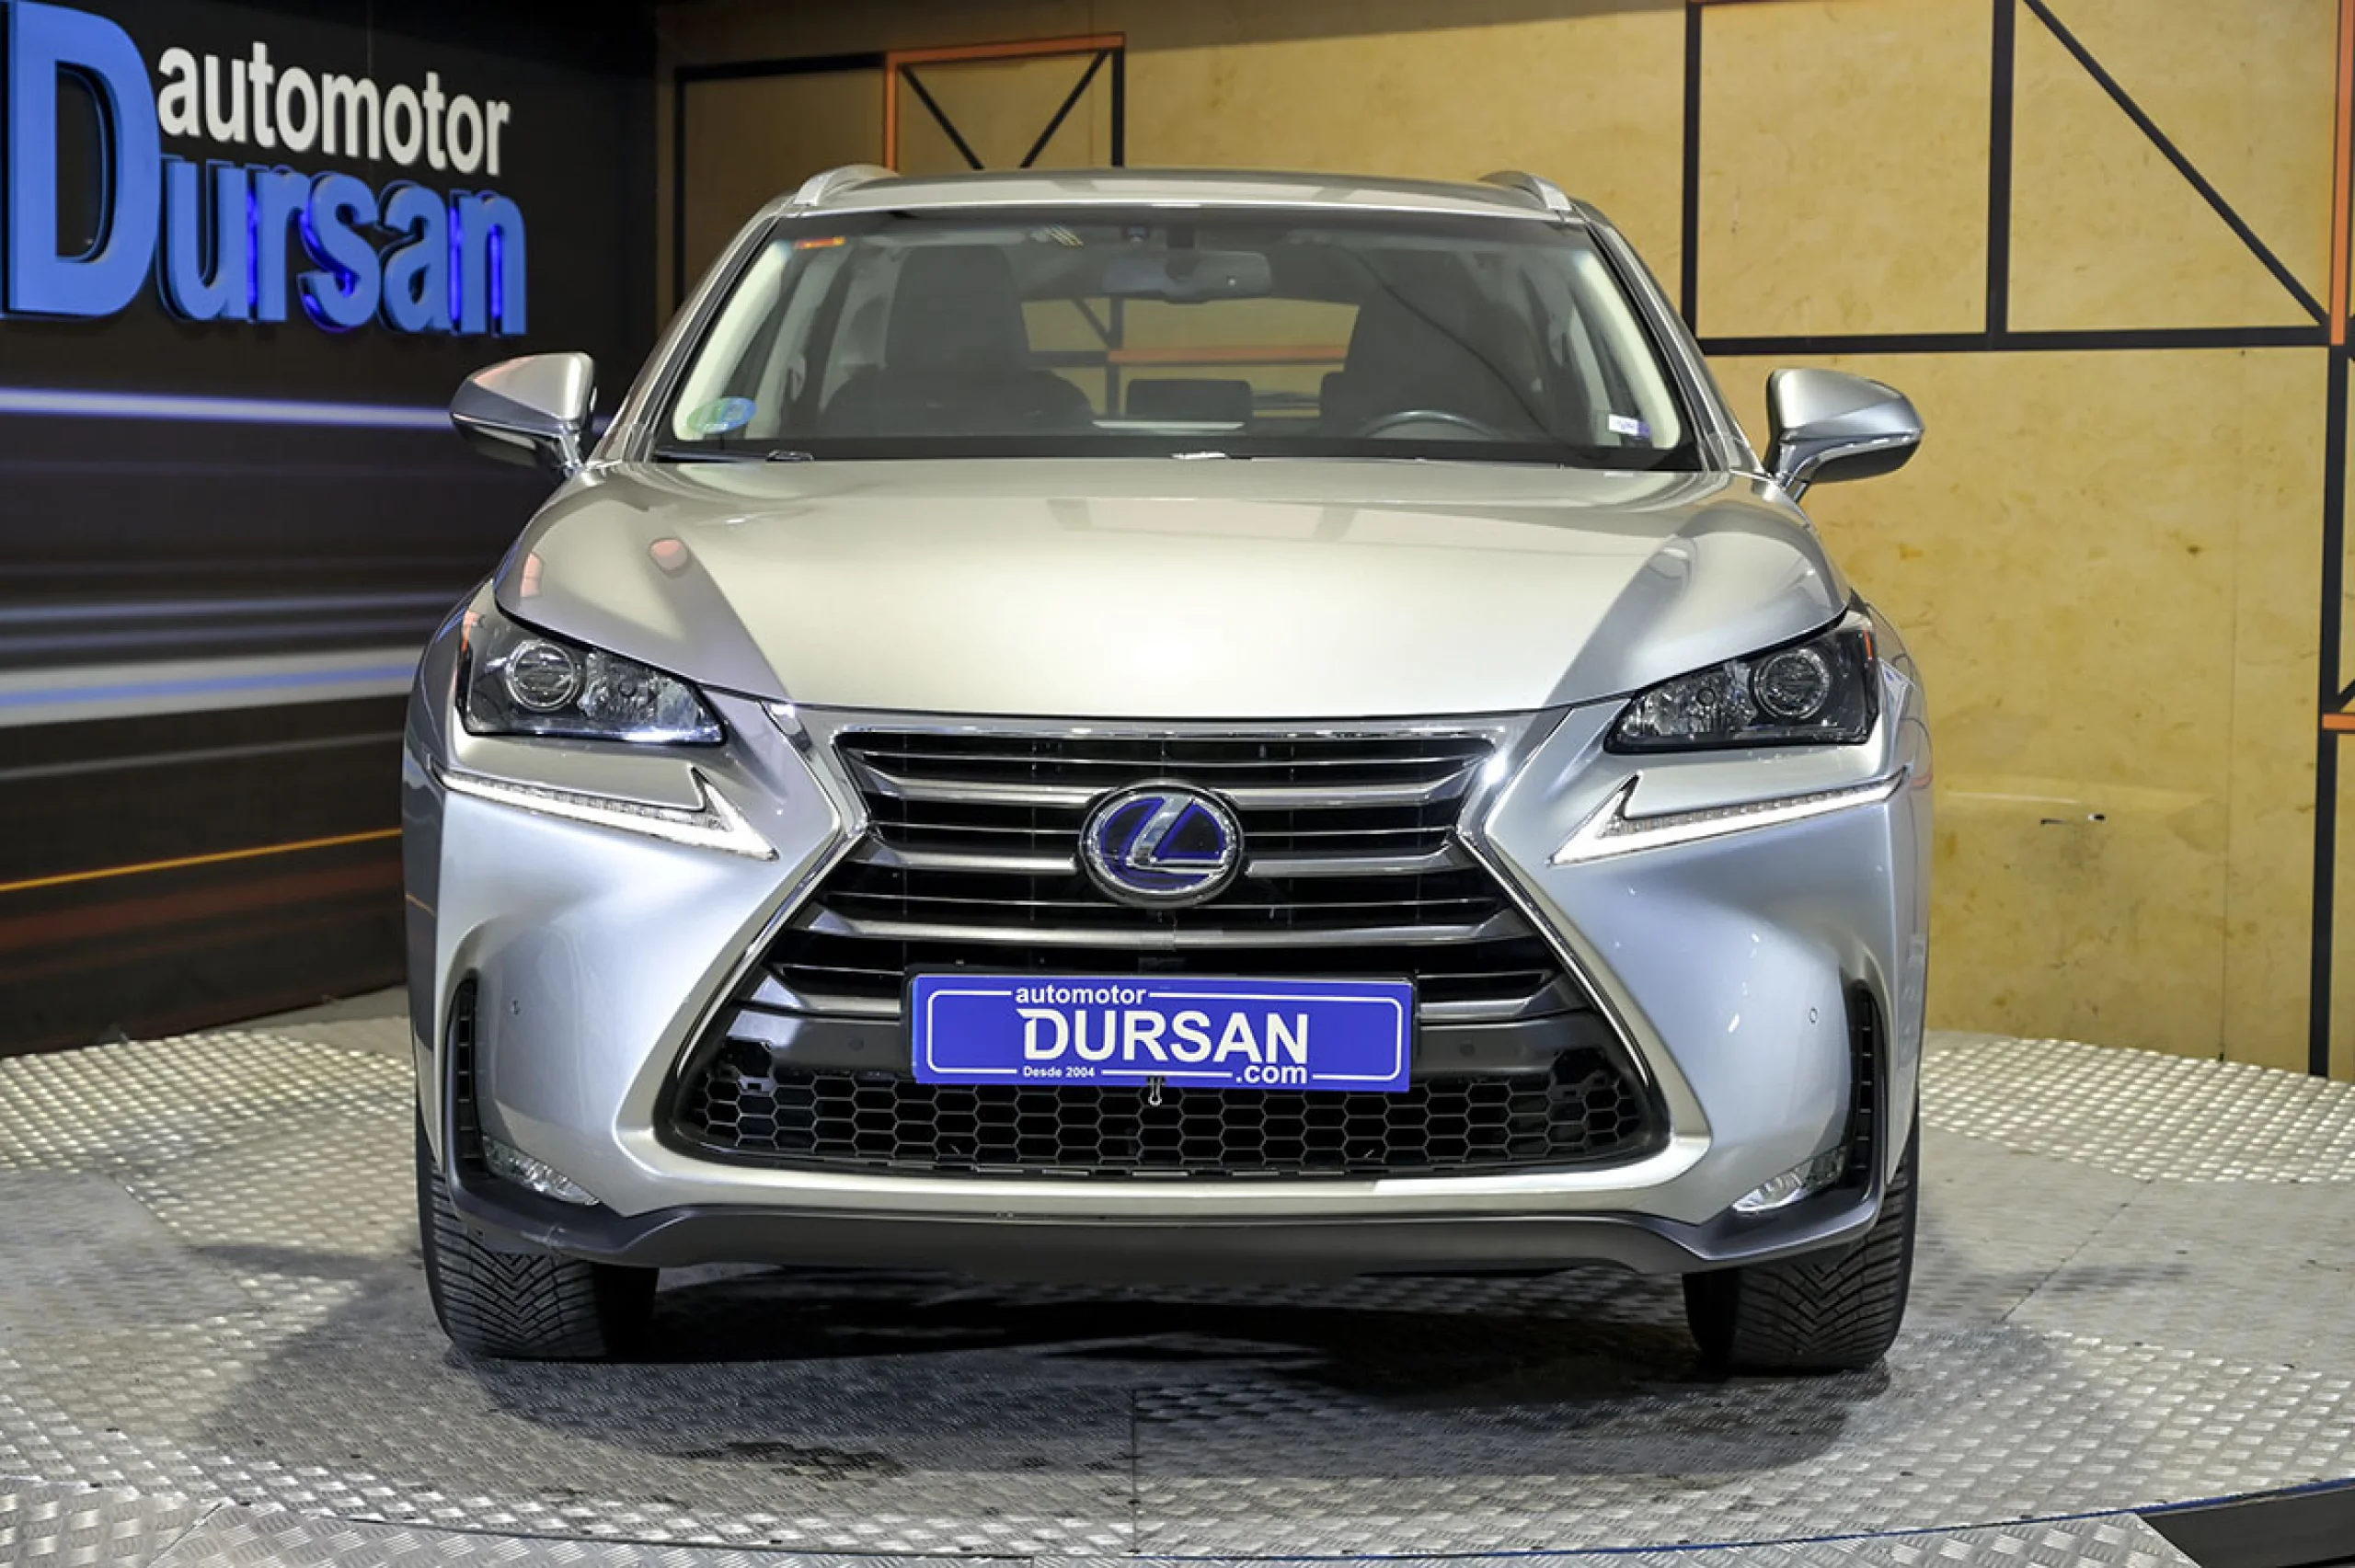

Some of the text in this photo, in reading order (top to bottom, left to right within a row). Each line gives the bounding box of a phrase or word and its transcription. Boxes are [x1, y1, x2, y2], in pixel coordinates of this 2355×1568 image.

[157, 41, 511, 176] automotor
[2, 1, 527, 335] Dursan
[1015, 984, 1147, 1005] automotor
[1016, 1008, 1309, 1064] DURSAN
[1022, 1064, 1096, 1079] Desde 2004
[1235, 1064, 1309, 1084] .com
